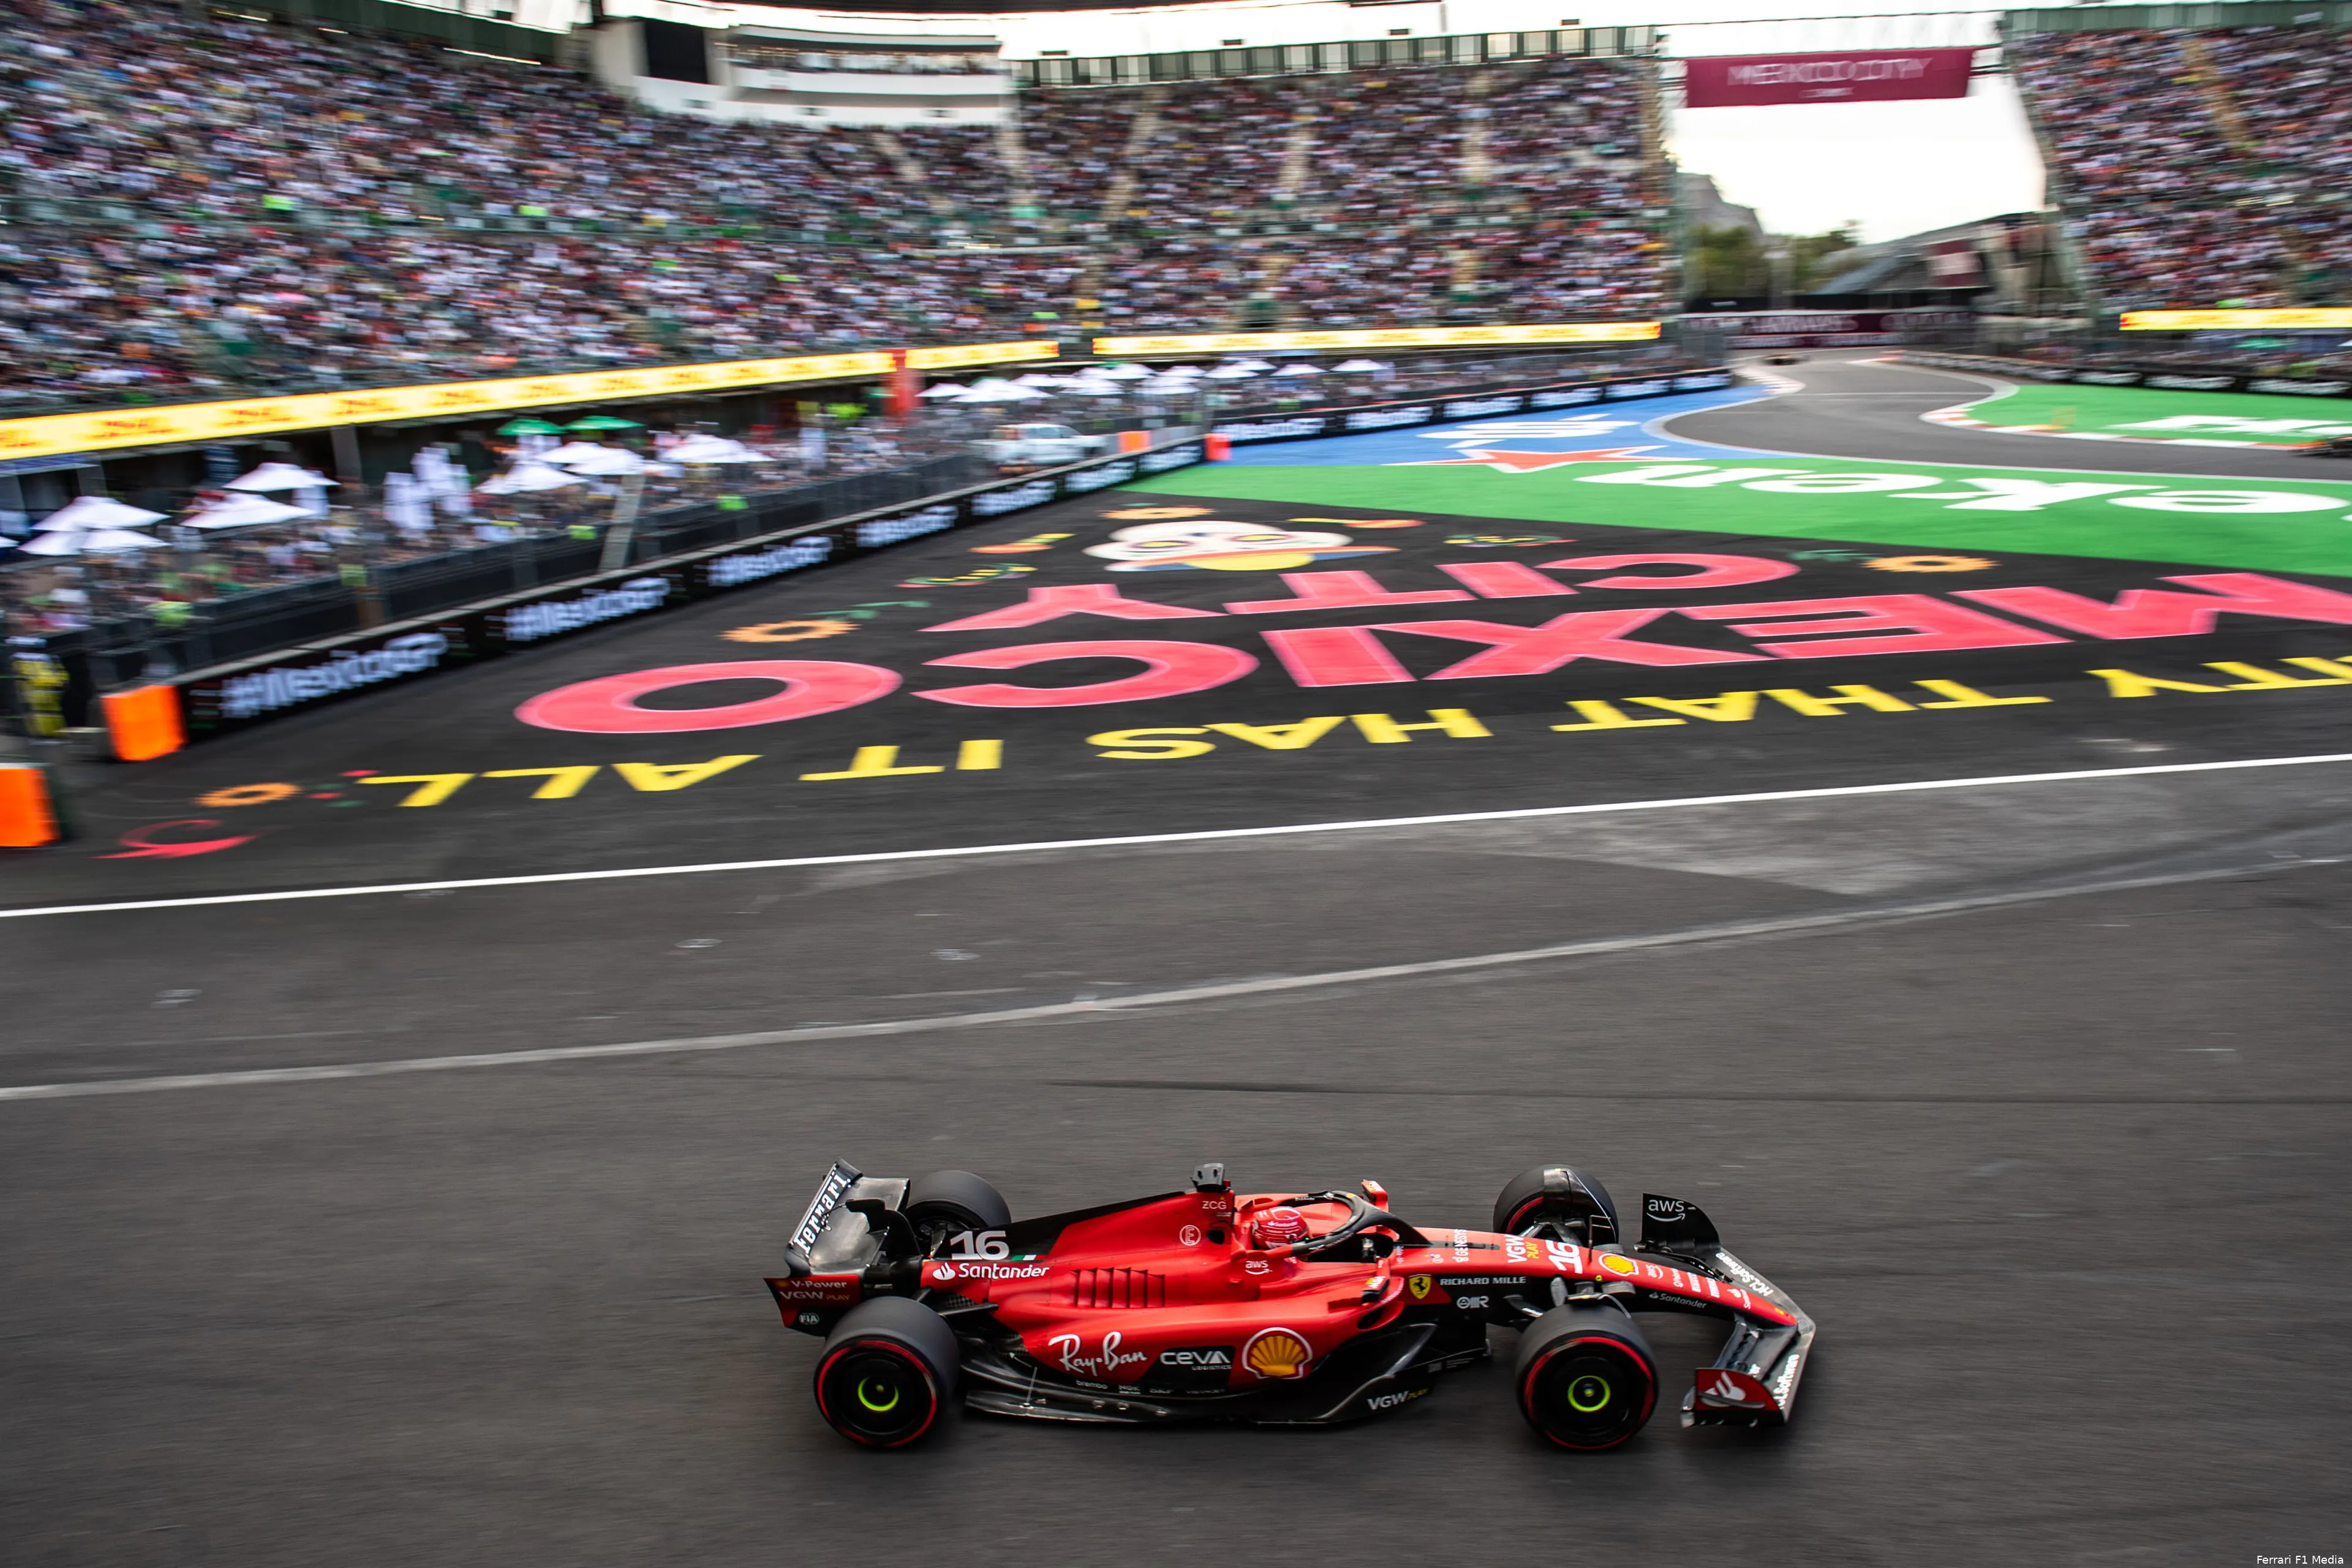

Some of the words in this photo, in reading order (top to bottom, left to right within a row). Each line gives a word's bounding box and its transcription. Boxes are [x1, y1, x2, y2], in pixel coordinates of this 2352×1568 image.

[919, 554, 1800, 631] CITY
[514, 573, 2352, 733] MEXICO
[2086, 656, 2352, 698] ITY
[1550, 680, 2053, 733] THAT
[1086, 707, 1493, 760] HAS
[800, 739, 1003, 781] IT
[357, 755, 761, 807] ALL
[1202, 1200, 1227, 1210] ZCG
[1648, 1198, 1685, 1213] aws
[949, 1230, 1010, 1261] 16
[1505, 1234, 1528, 1263] VGW
[1545, 1240, 1583, 1274] 16
[959, 1263, 1049, 1280] Santander
[1245, 1261, 1269, 1270] aws
[790, 1280, 848, 1289] V-Power
[1440, 1277, 1490, 1286] RICHARD
[1492, 1276, 1526, 1284] MILLE
[779, 1291, 824, 1300] VGW
[1659, 1292, 1707, 1309] Santander
[799, 1314, 820, 1324] FIA
[1368, 1391, 1409, 1411] VGW
